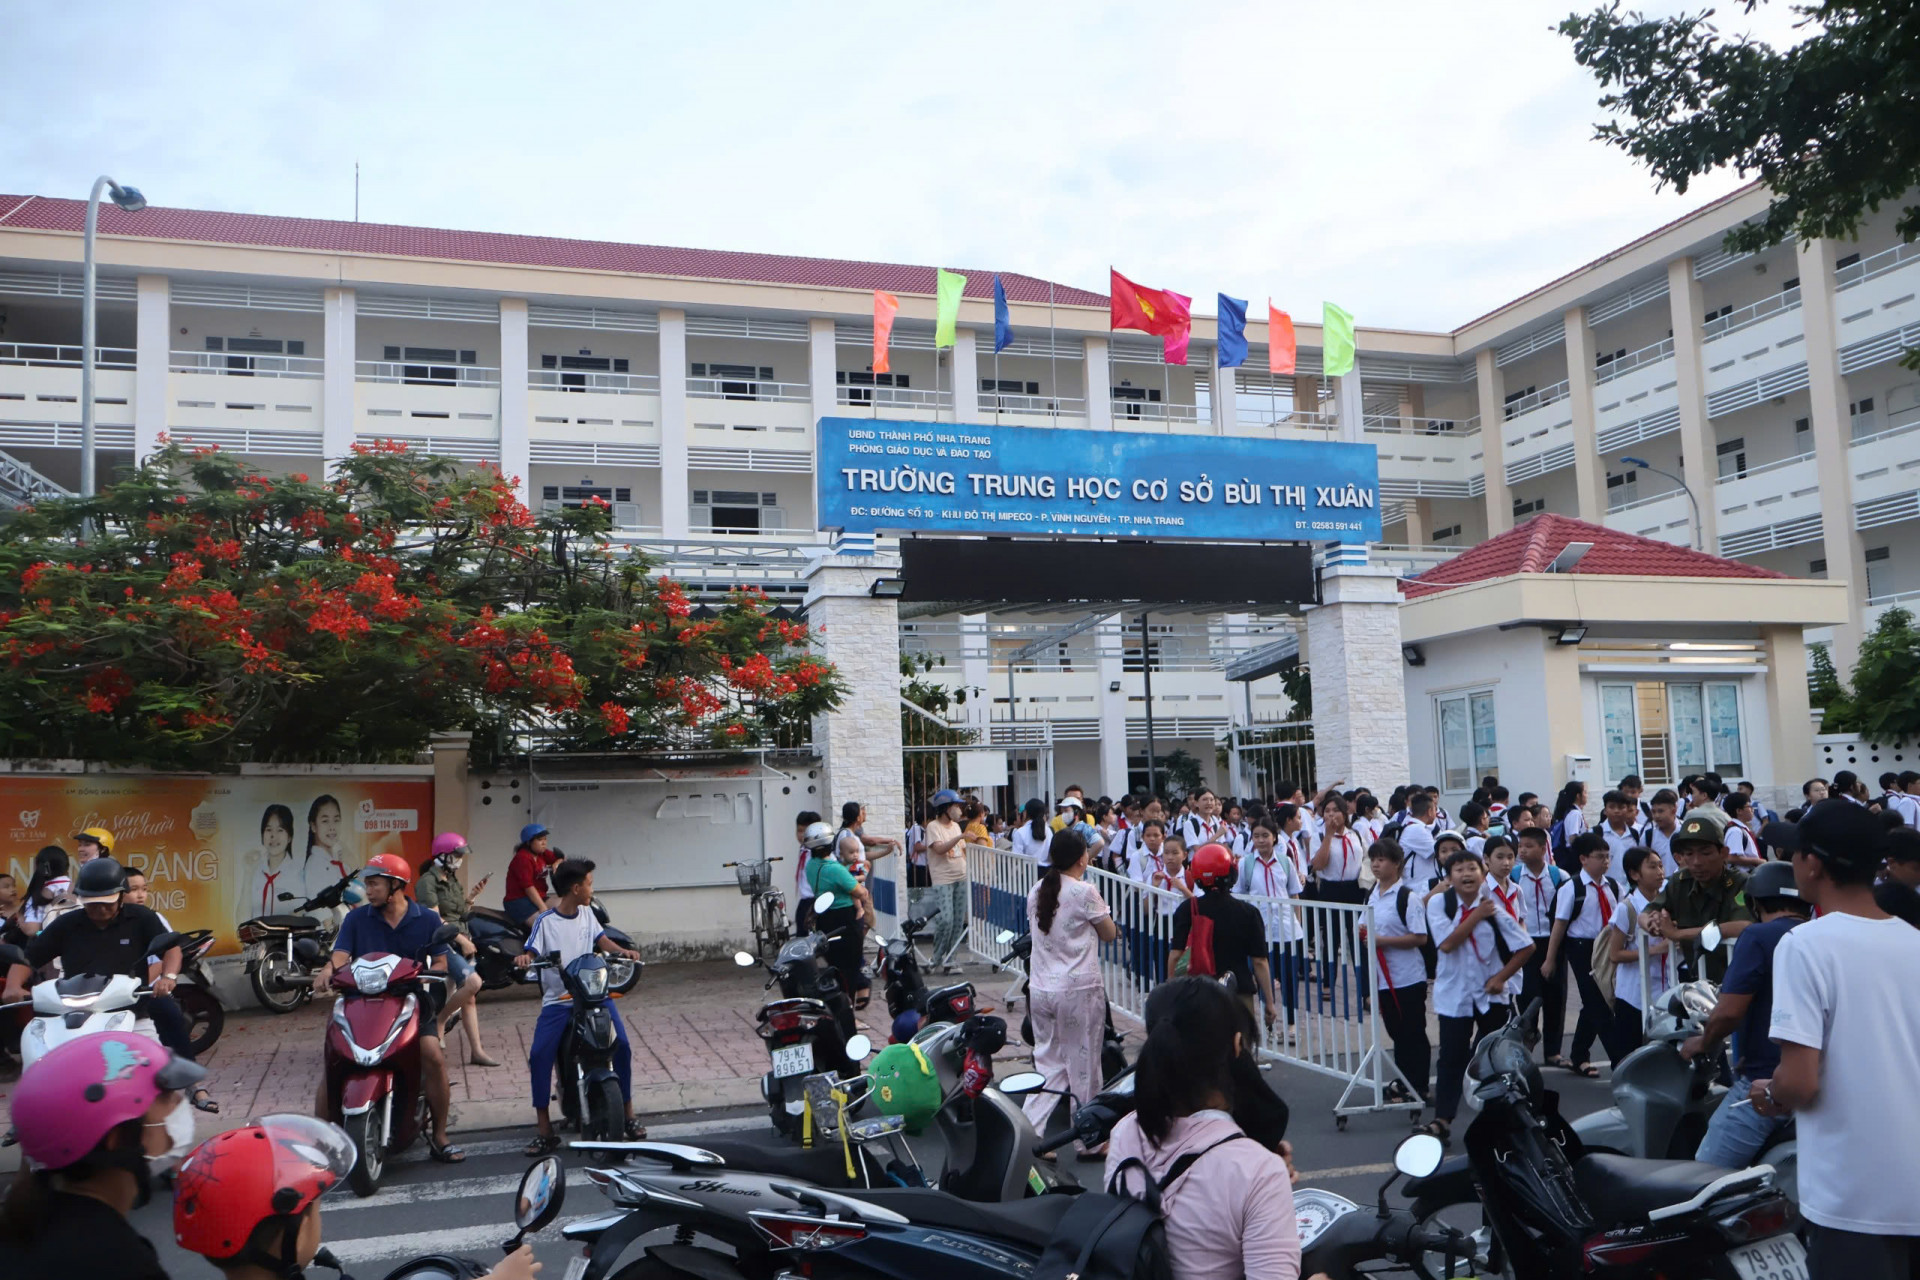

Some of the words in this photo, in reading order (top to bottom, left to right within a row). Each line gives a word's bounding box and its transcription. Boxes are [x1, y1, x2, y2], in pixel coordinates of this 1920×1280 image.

[848, 429, 876, 440] UBND
[879, 430, 912, 441] THÀNH
[913, 430, 934, 442] PHỐ
[936, 433, 956, 443] NHA
[958, 435, 991, 445] TRANG
[849, 442, 884, 454] PHÒNG
[886, 443, 910, 455] GIÁO
[913, 447, 933, 458] DỤC
[935, 445, 947, 457] VÀ
[950, 447, 970, 458] ĐÀO
[973, 449, 992, 460] TẠO
[842, 463, 956, 495] TRƯỜNG
[968, 473, 1056, 498] TRUNG
[1067, 477, 1121, 505] HỌC
[1132, 477, 1168, 501] CƠ
[1180, 473, 1213, 502] SỞ
[1225, 477, 1261, 504] BÙI
[1270, 484, 1306, 511] THỊ
[1316, 482, 1374, 508] XUÂN
[850, 507, 868, 516] ĐC:
[870, 505, 905, 517] ĐƯỜNG
[907, 506, 921, 518] SỐ
[924, 509, 934, 518] 10
[941, 510, 961, 519] KHU
[964, 509, 978, 520] ĐÔ
[981, 511, 996, 522] THỊ
[998, 511, 1033, 521] MIPECO
[1041, 513, 1049, 522] P.
[1118, 516, 1132, 525] TP.
[1133, 516, 1152, 525] NHA
[1154, 516, 1184, 526] TRANG
[1311, 521, 1334, 530] 02583
[1335, 522, 1347, 531] 591
[1349, 522, 1362, 531] 441
[364, 819, 378, 830] 098
[127, 845, 219, 883] RĂNG
[776, 1058, 811, 1076] 896.51
[720, 1186, 763, 1197] mode
[1740, 1241, 1796, 1274] 79-H1
